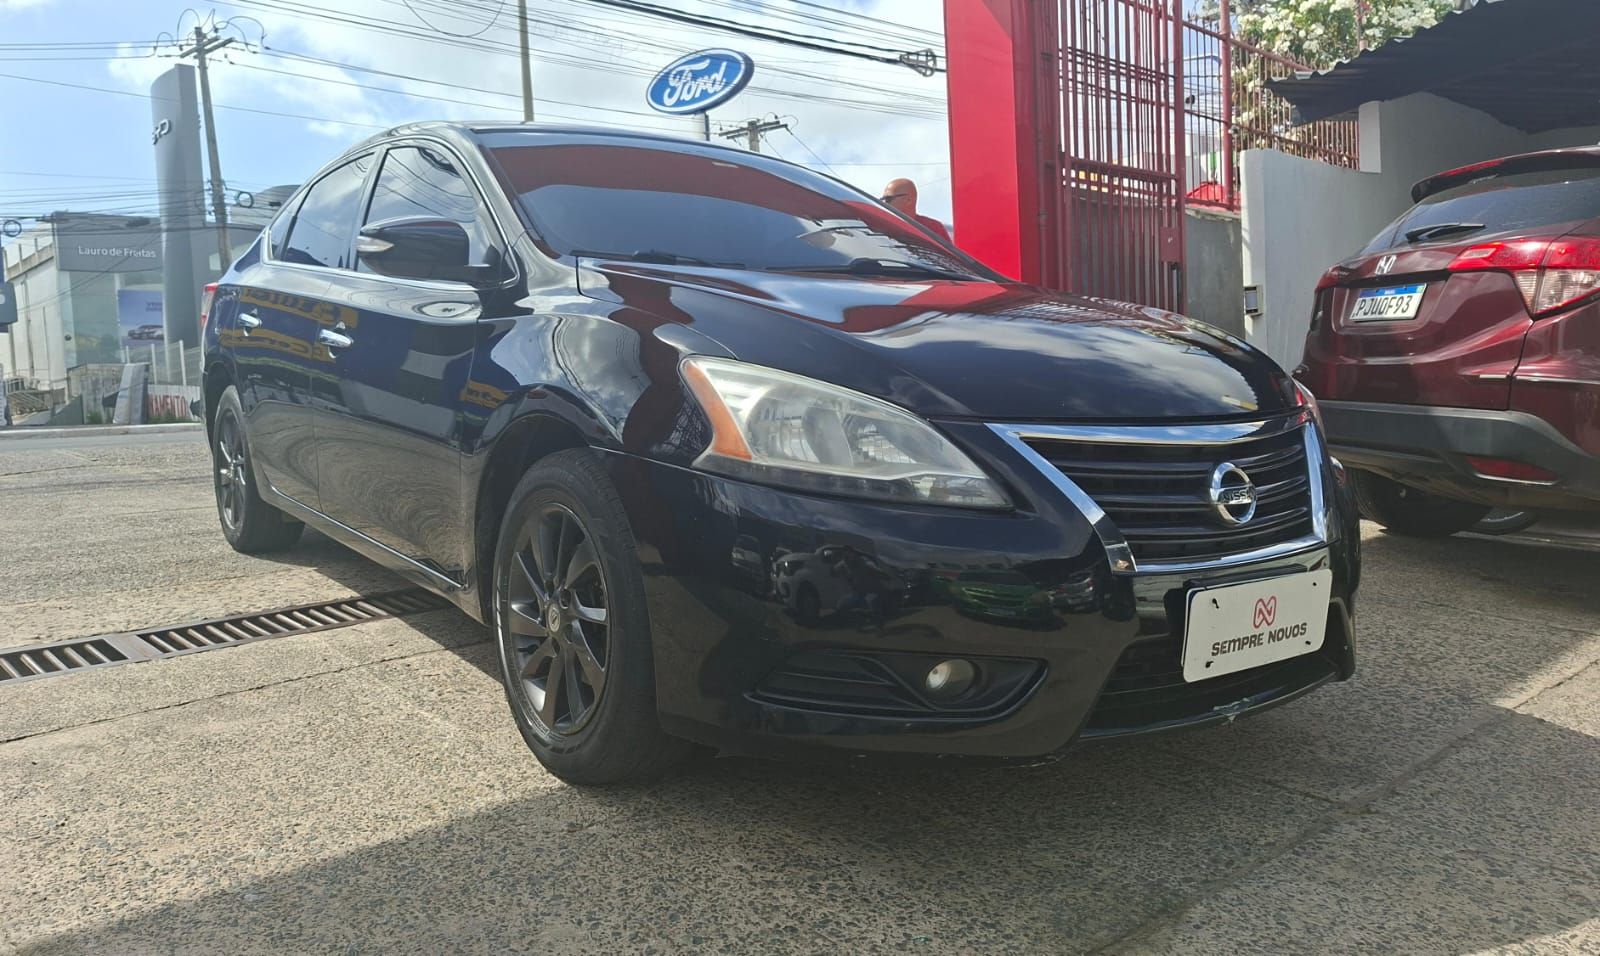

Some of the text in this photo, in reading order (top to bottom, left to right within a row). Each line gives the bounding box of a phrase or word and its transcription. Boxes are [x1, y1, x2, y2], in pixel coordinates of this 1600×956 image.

[663, 58, 727, 107] Ford
[78, 245, 156, 258] Lauro de Freitas
[1211, 622, 1308, 657] SEMPRE NOVOS
